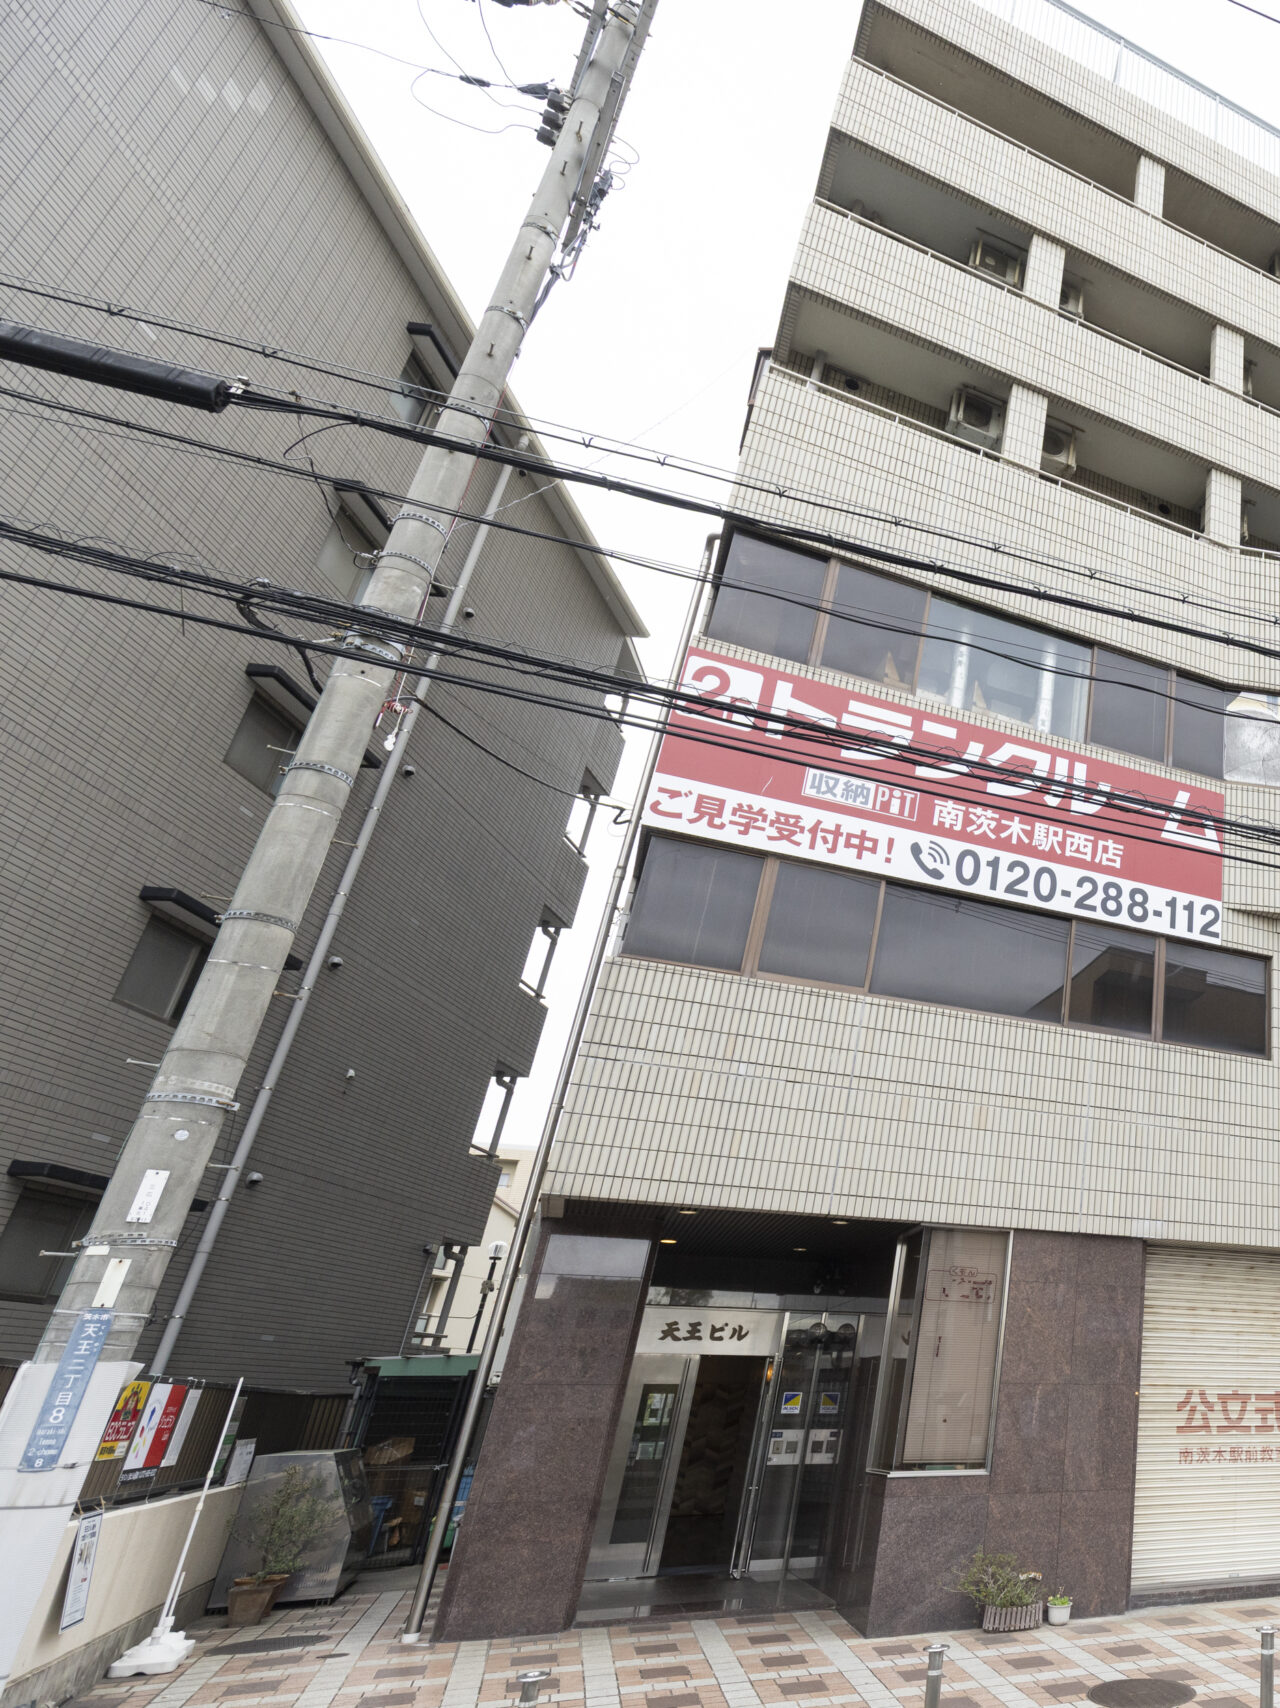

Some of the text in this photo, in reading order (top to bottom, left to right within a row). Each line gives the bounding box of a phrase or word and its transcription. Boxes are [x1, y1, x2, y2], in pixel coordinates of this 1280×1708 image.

[932, 799, 1125, 869] 南茨木駅西店
[955, 848, 1220, 939] 0120-288-112
[82, 1313, 110, 1321] 茨木市
[658, 1320, 750, 1342] 天王ビル
